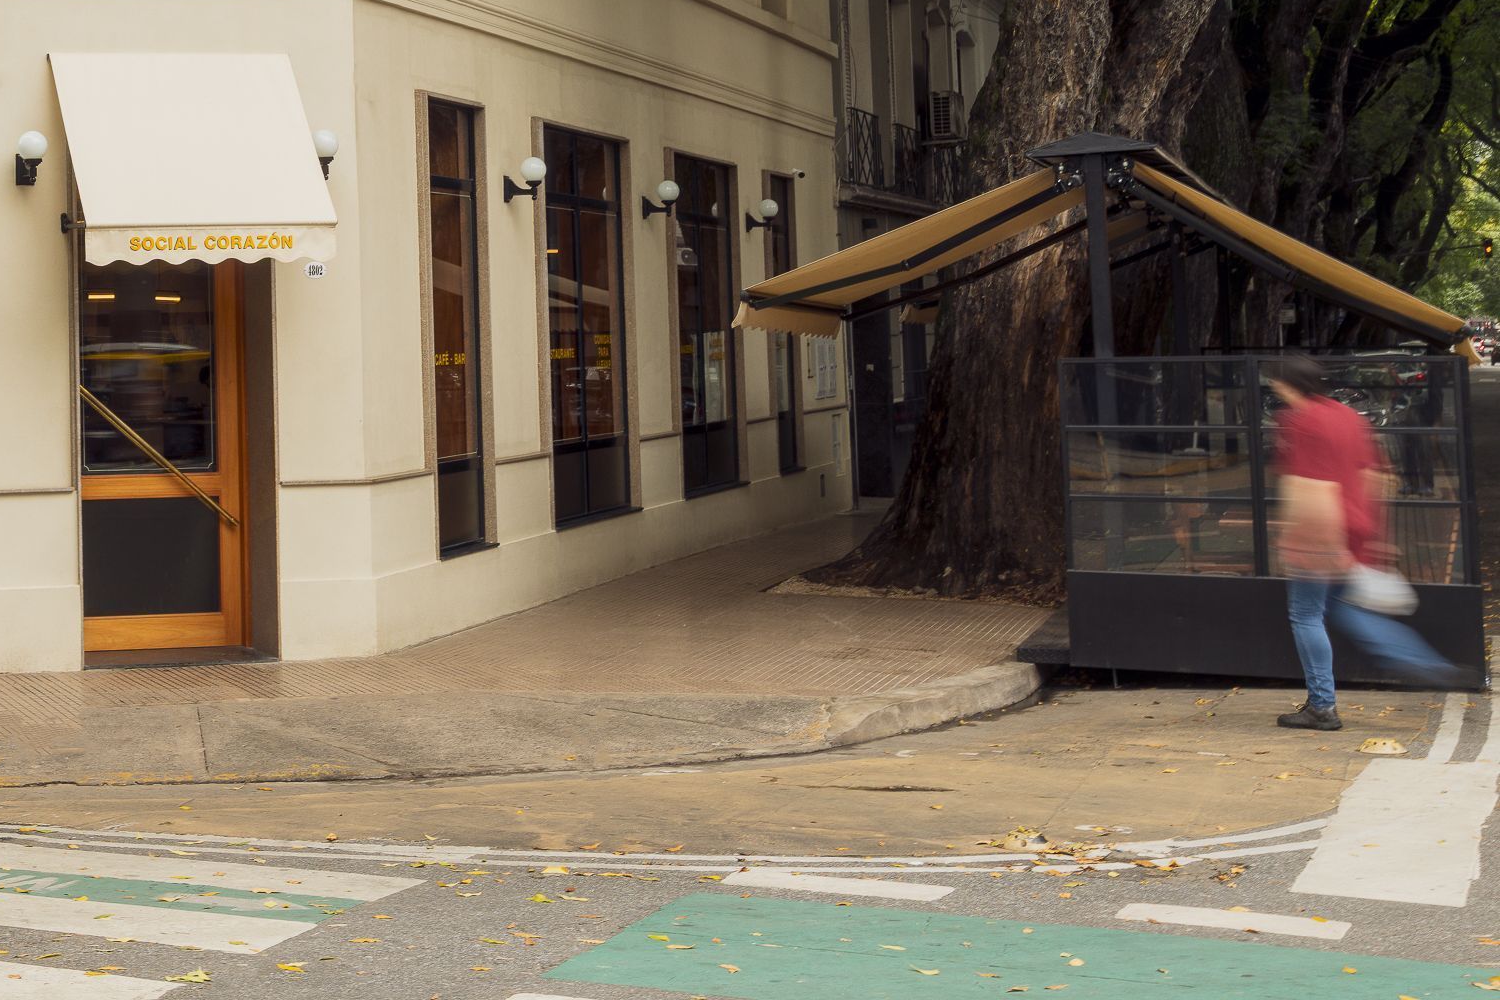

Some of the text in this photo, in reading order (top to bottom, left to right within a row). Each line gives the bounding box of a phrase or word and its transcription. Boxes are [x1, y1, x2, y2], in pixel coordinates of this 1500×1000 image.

[129, 232, 293, 251] SOCIAL CORAZÓN
[308, 264, 323, 276] 4802
[454, 353, 466, 365] BAR
